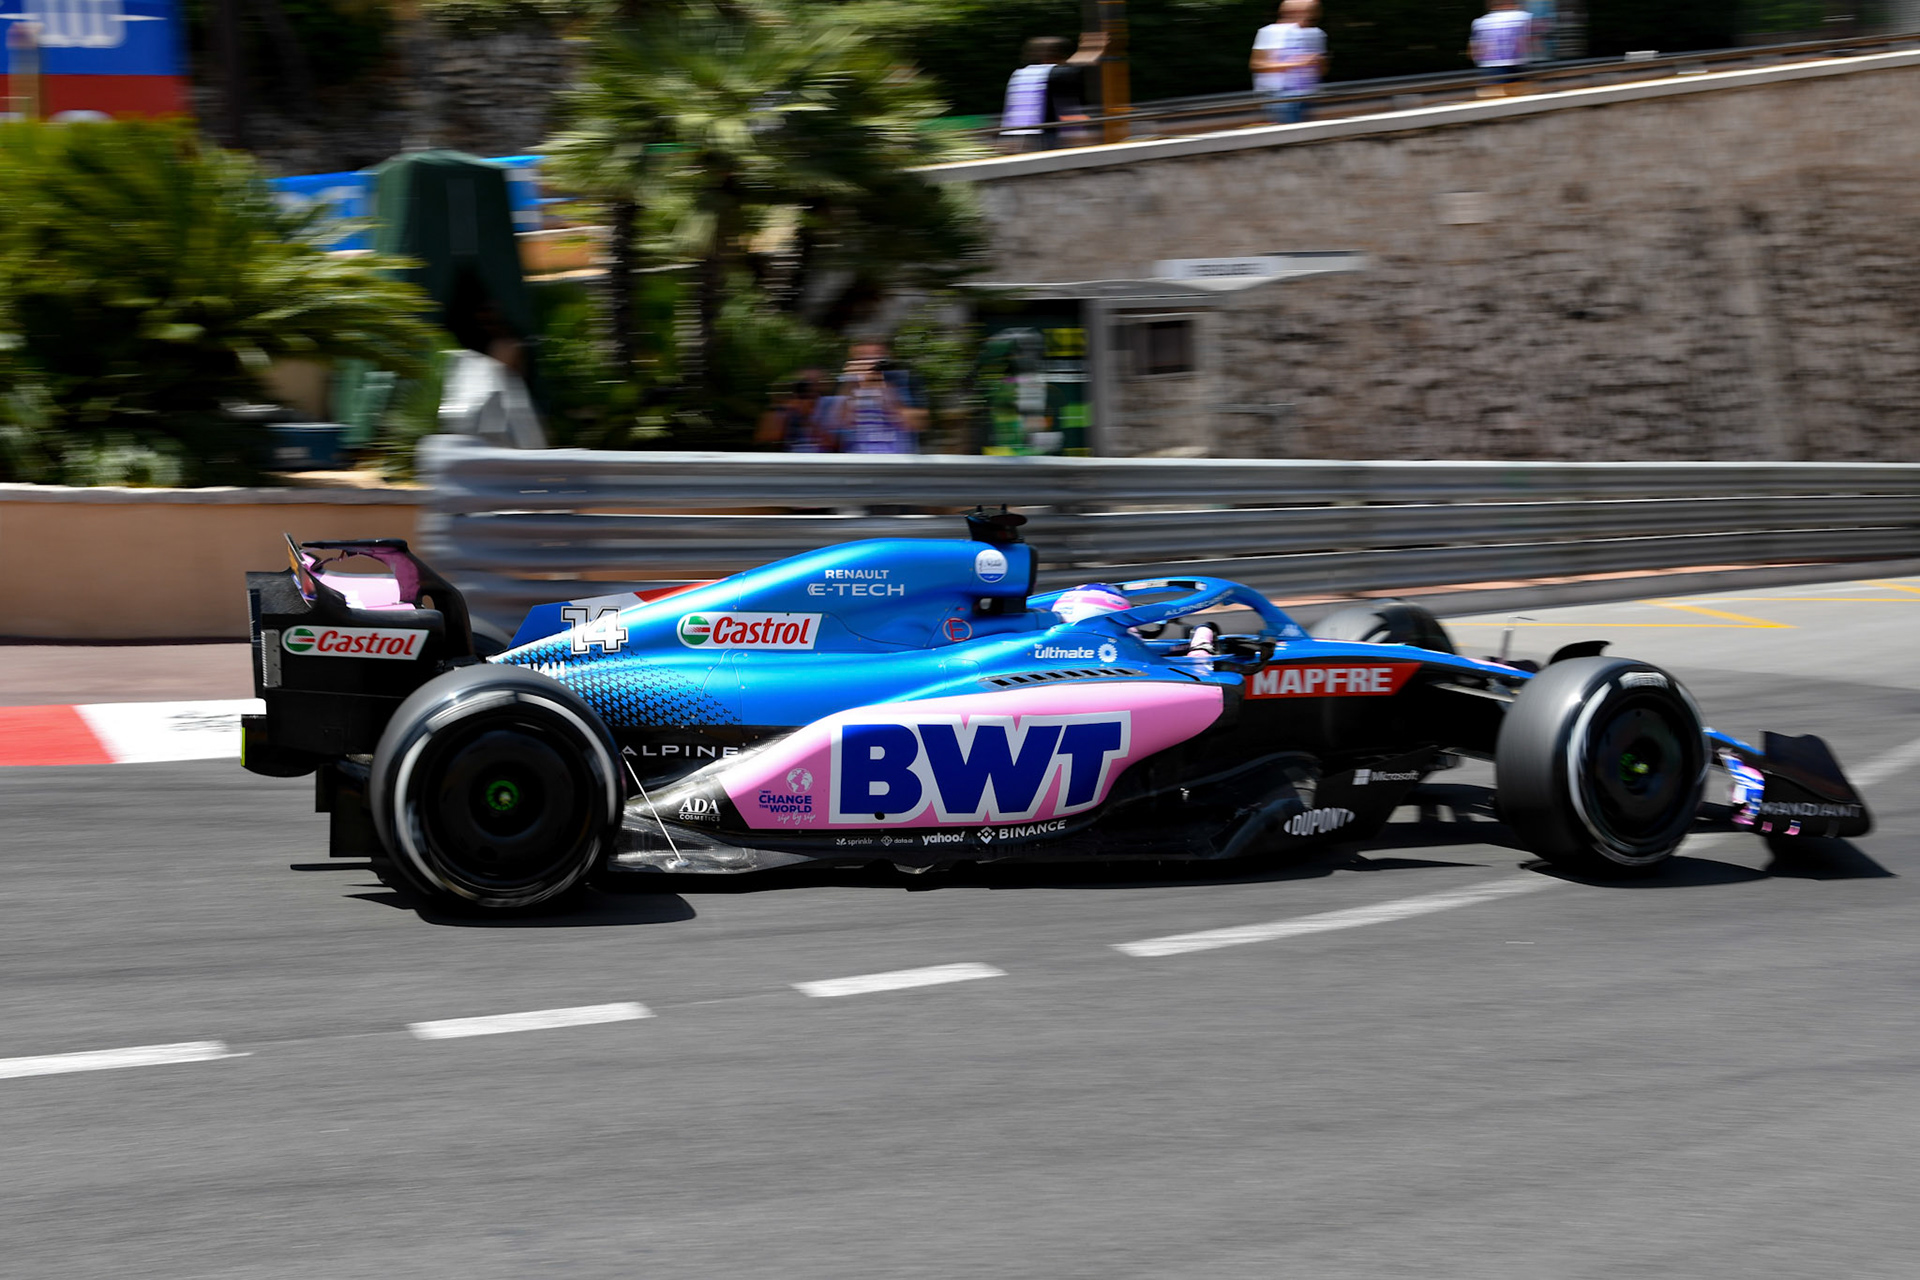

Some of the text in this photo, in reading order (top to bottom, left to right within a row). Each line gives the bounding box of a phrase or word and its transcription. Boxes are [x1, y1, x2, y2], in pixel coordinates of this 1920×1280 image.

[825, 569, 889, 579] RENAULT
[807, 583, 905, 596] E-TECH
[561, 606, 629, 654] 14
[712, 616, 810, 645] Castrol
[317, 630, 417, 656] Castrol
[1034, 647, 1095, 659] ultimate
[1252, 667, 1393, 695] MAPFRE
[621, 745, 739, 758] ALPINE
[837, 717, 1127, 819] BWT
[1371, 770, 1419, 782] Microsoft
[679, 798, 720, 814] ADA
[759, 794, 812, 804] CHANGE
[770, 804, 813, 813] WORLD
[679, 814, 721, 822] COSMETICS
[1290, 807, 1349, 836] DUPONT
[999, 820, 1067, 839] BINANCE
[922, 832, 965, 846] yahoo!
